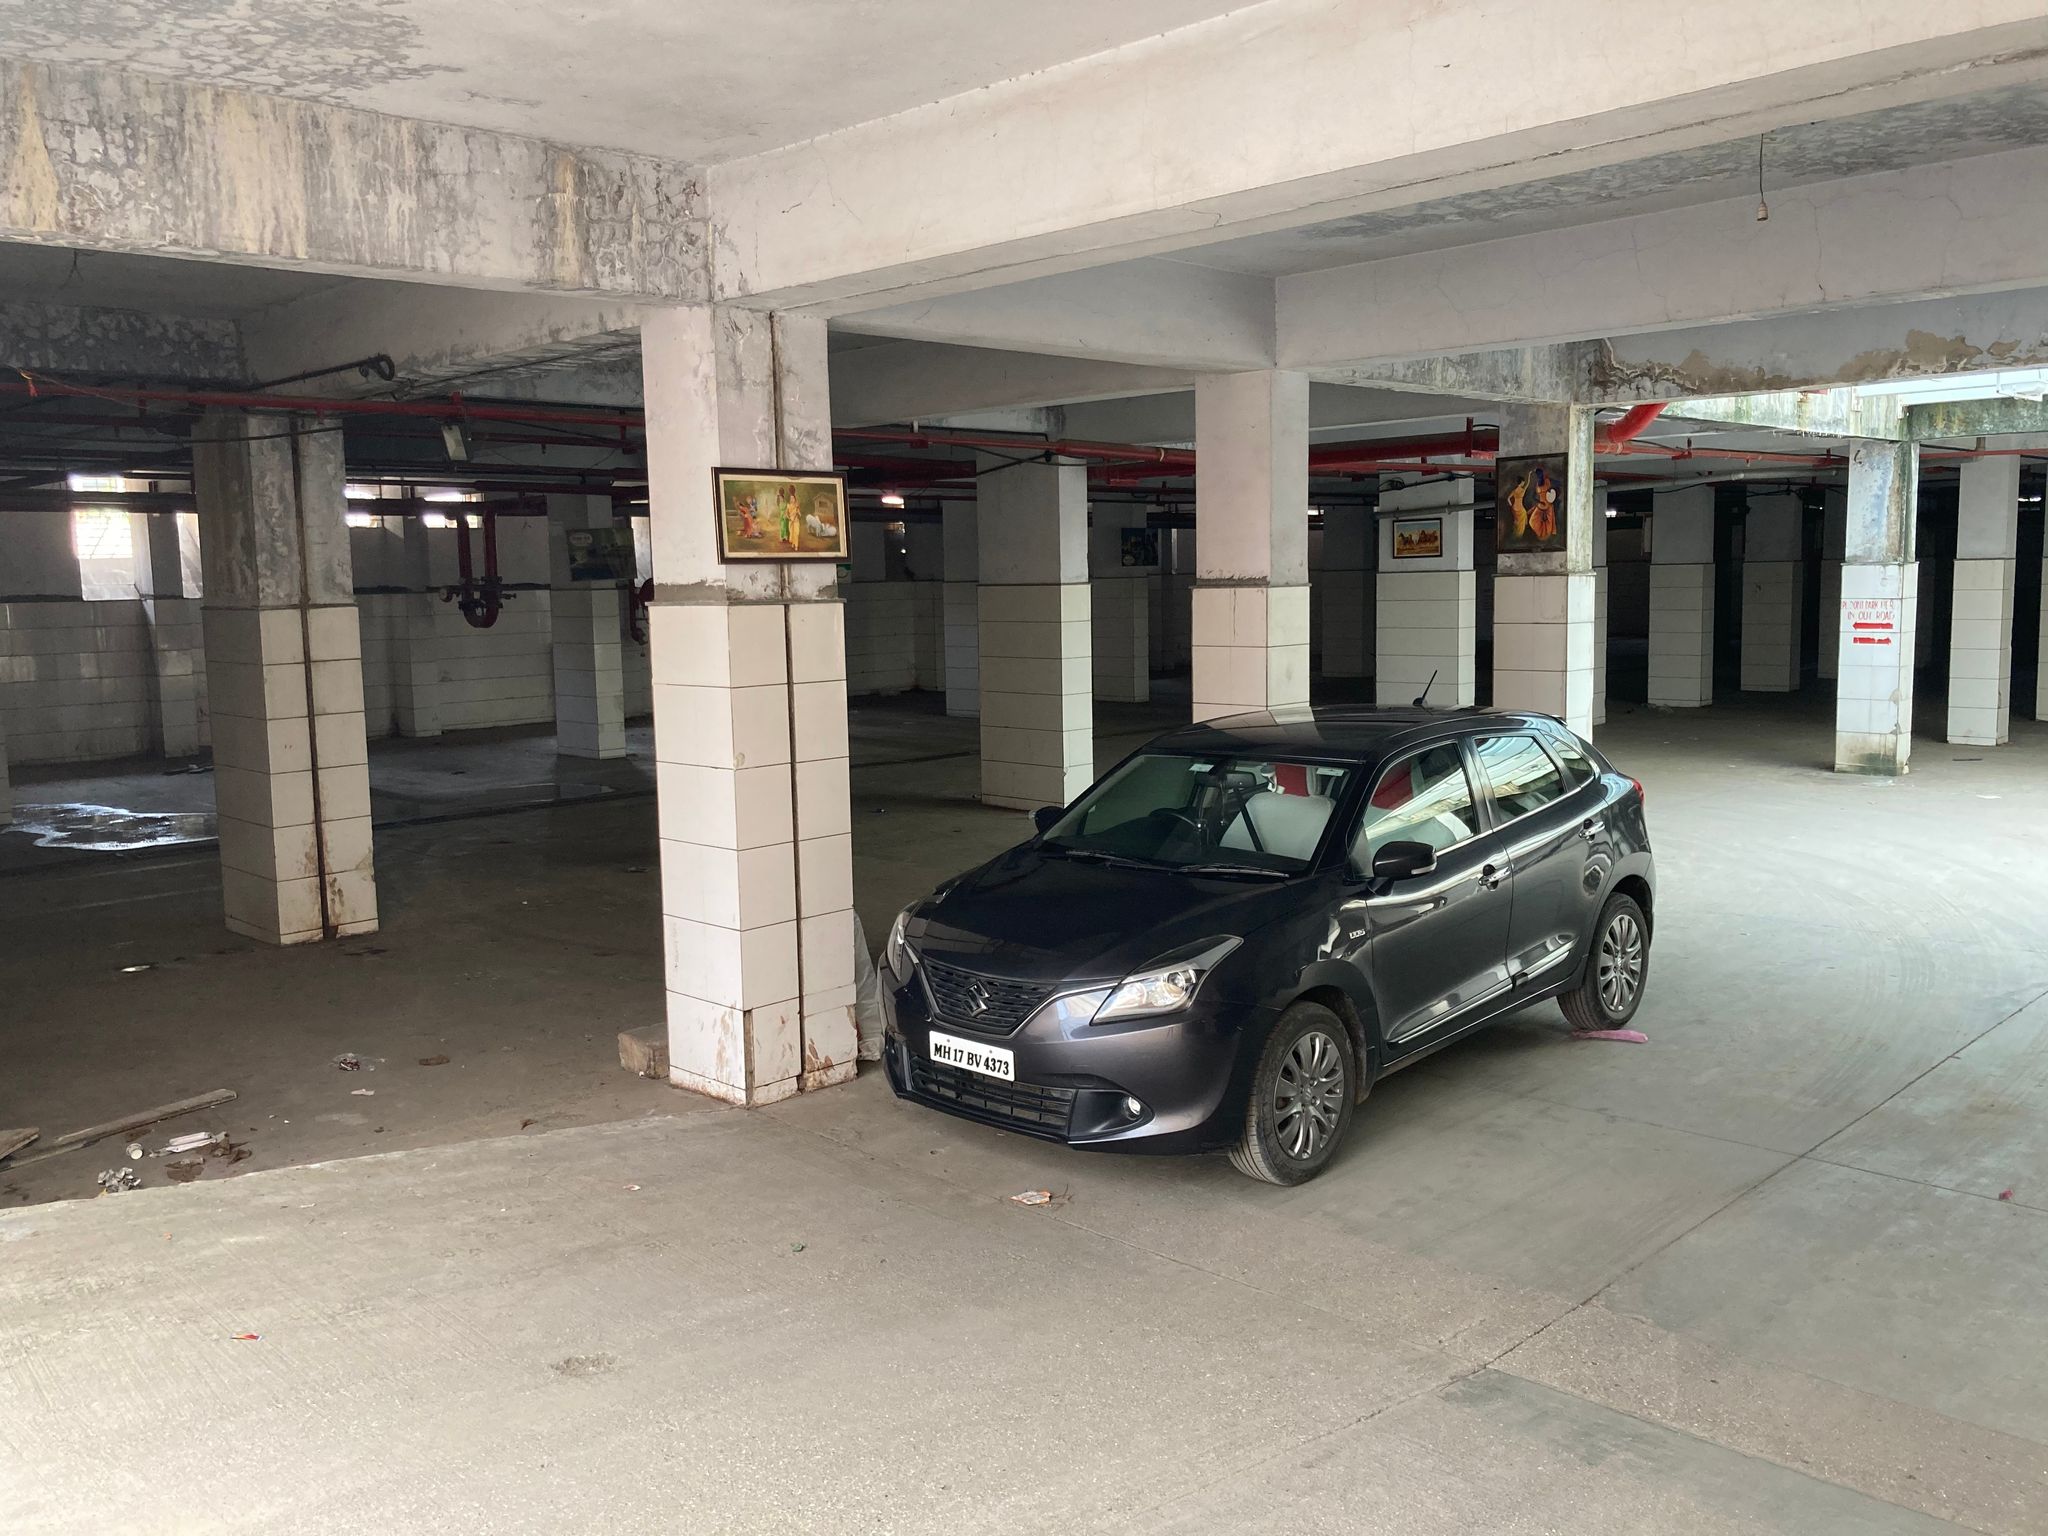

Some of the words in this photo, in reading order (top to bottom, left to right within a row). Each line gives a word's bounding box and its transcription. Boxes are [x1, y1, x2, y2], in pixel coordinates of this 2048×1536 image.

[933, 1043, 951, 1060] MH
[953, 1048, 964, 1063] 17
[967, 1052, 982, 1068] BV
[983, 1057, 1009, 1075] 4373
